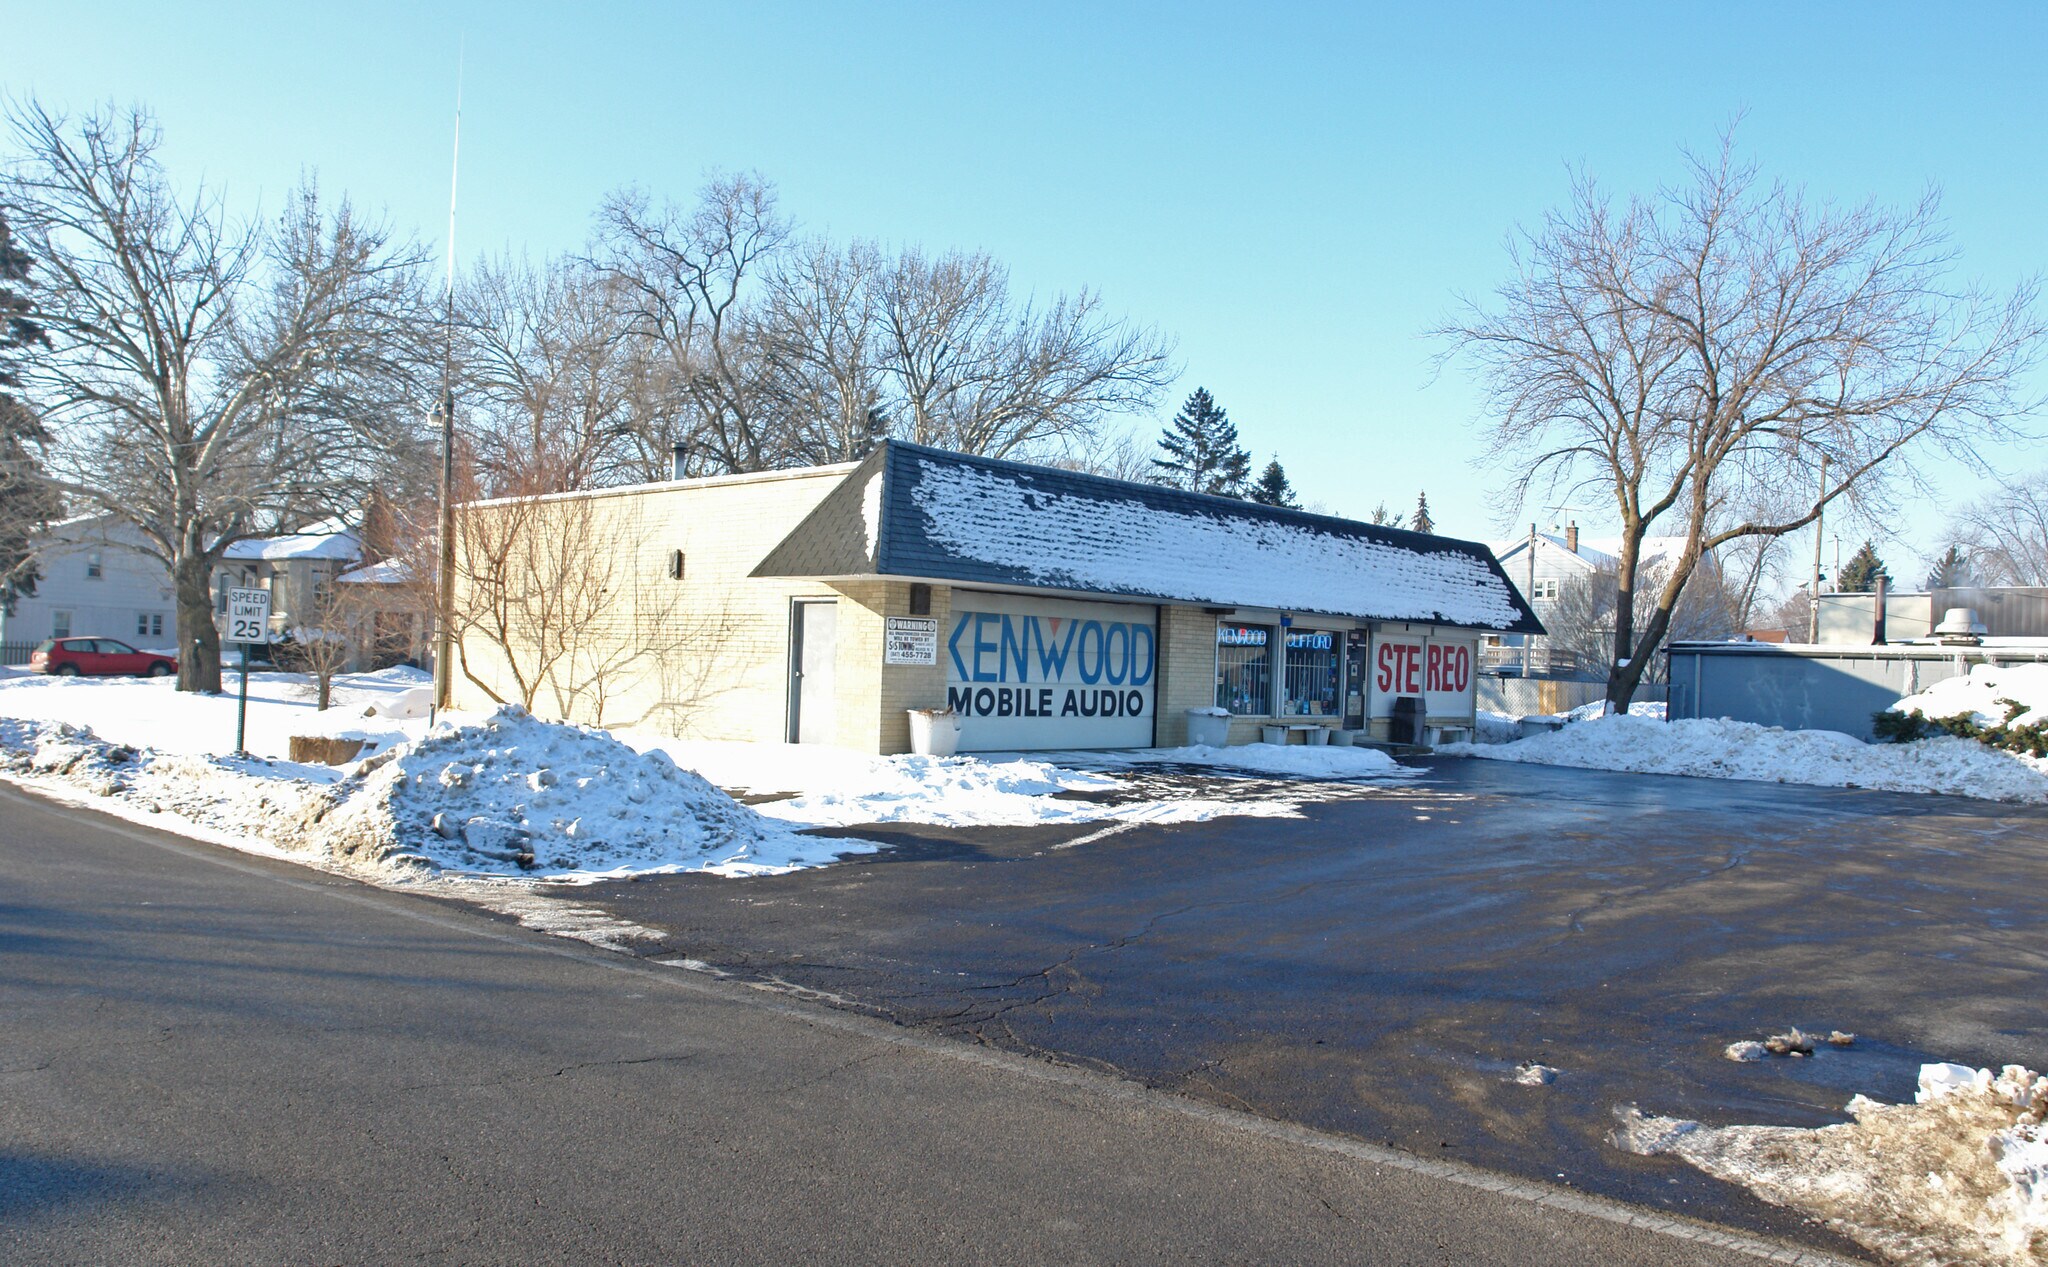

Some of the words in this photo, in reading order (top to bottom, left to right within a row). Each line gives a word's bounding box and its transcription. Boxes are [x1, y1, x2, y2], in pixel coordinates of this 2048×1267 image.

[231, 592, 267, 604] SPEED
[234, 605, 262, 617] LIMIT
[234, 620, 260, 638] 25
[897, 620, 928, 631] WARNING
[1217, 628, 1267, 646] KENWOOD
[1286, 633, 1332, 650] CLIFFORD
[948, 612, 1154, 686] KENWOOD
[1377, 643, 1470, 693] STEREO
[948, 687, 1053, 717] MOBILE
[1060, 689, 1144, 717] AUDIO
